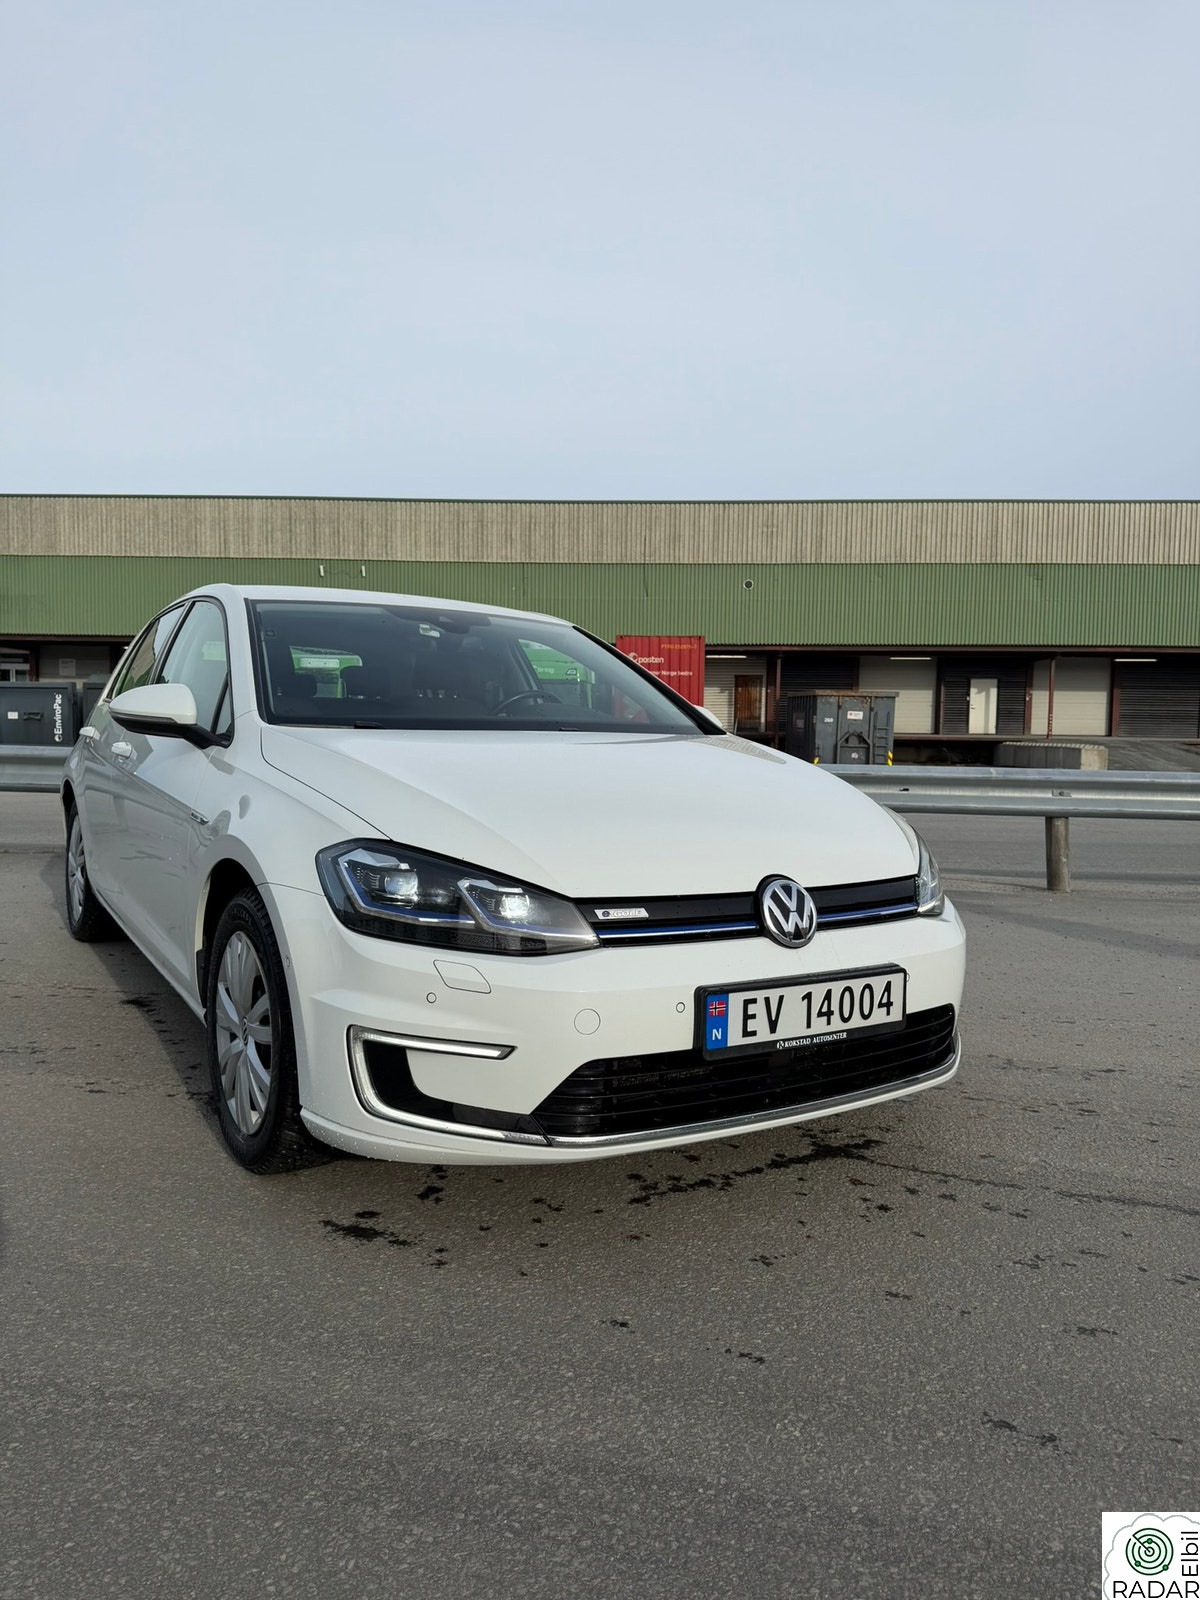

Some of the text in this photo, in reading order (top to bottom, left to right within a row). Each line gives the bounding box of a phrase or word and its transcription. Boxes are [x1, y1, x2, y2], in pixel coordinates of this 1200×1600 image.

[638, 656, 664, 664] posten
[53, 693, 62, 734] EnviroPac
[742, 980, 893, 1038] EV 14004
[712, 1028, 722, 1040] N
[785, 1032, 847, 1048] KOKSTAD AUTOSENTER
